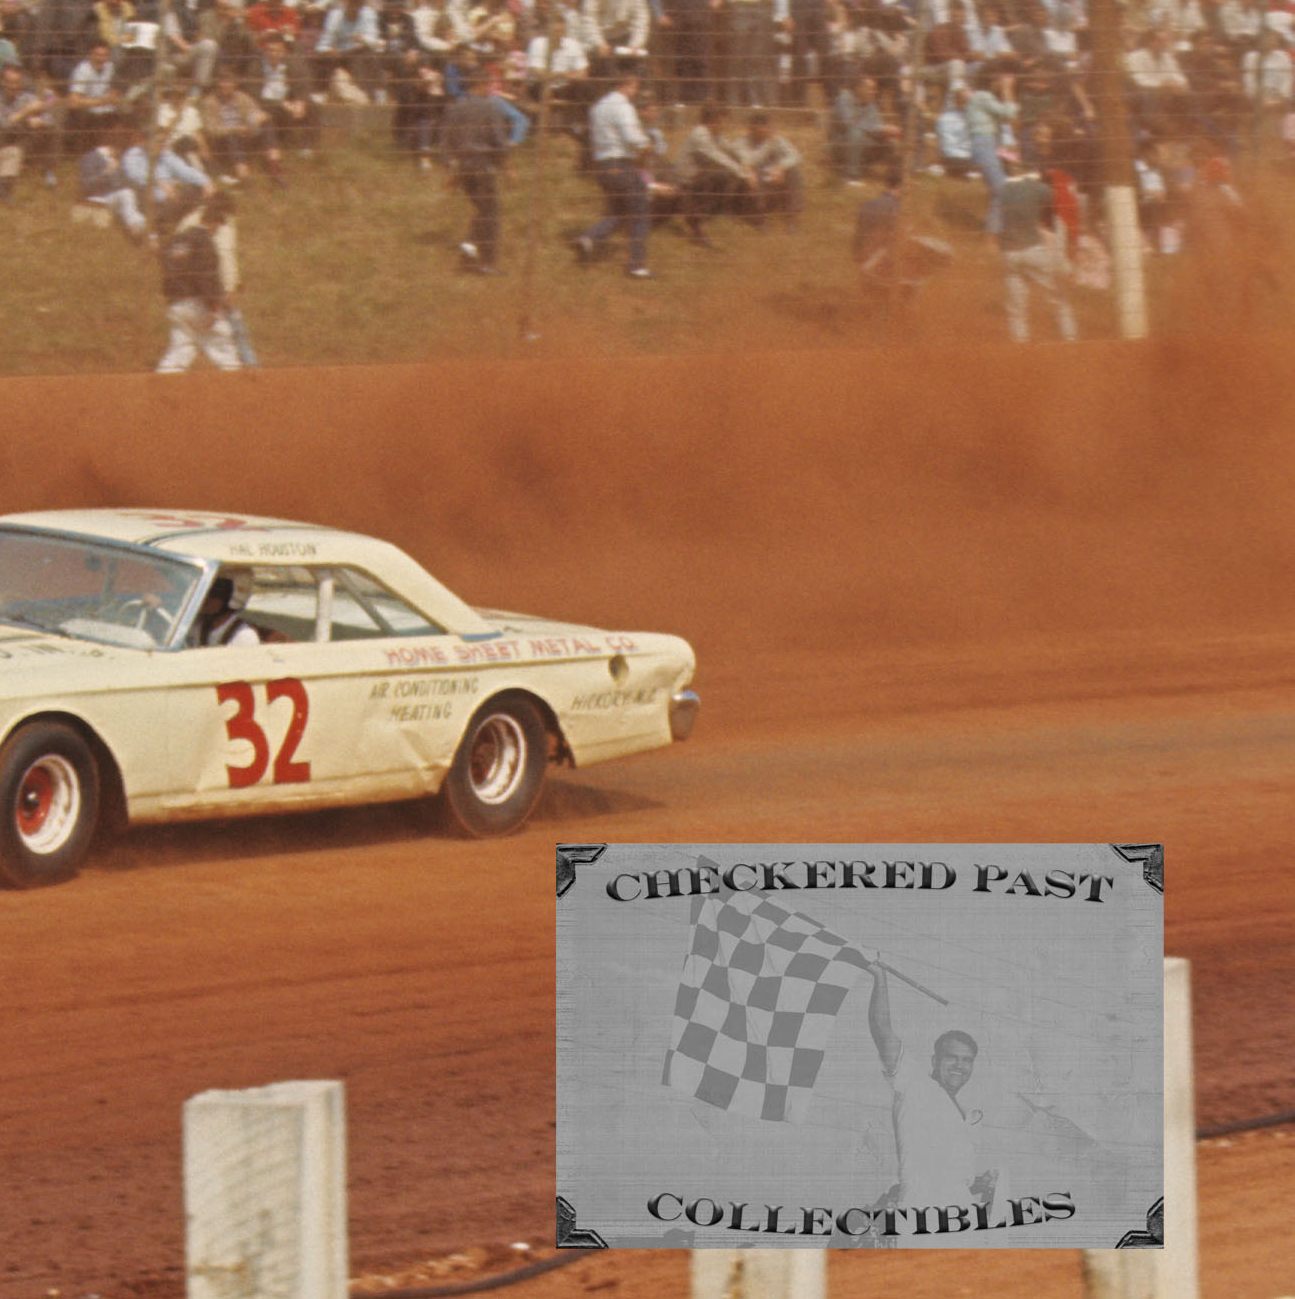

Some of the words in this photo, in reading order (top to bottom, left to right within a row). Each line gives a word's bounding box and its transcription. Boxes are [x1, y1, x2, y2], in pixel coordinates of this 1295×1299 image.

[384, 645, 447, 665] HOME
[453, 640, 520, 662] SHEET
[530, 637, 601, 657] METAL
[390, 701, 452, 721] HEATING
[216, 677, 310, 788] 32
